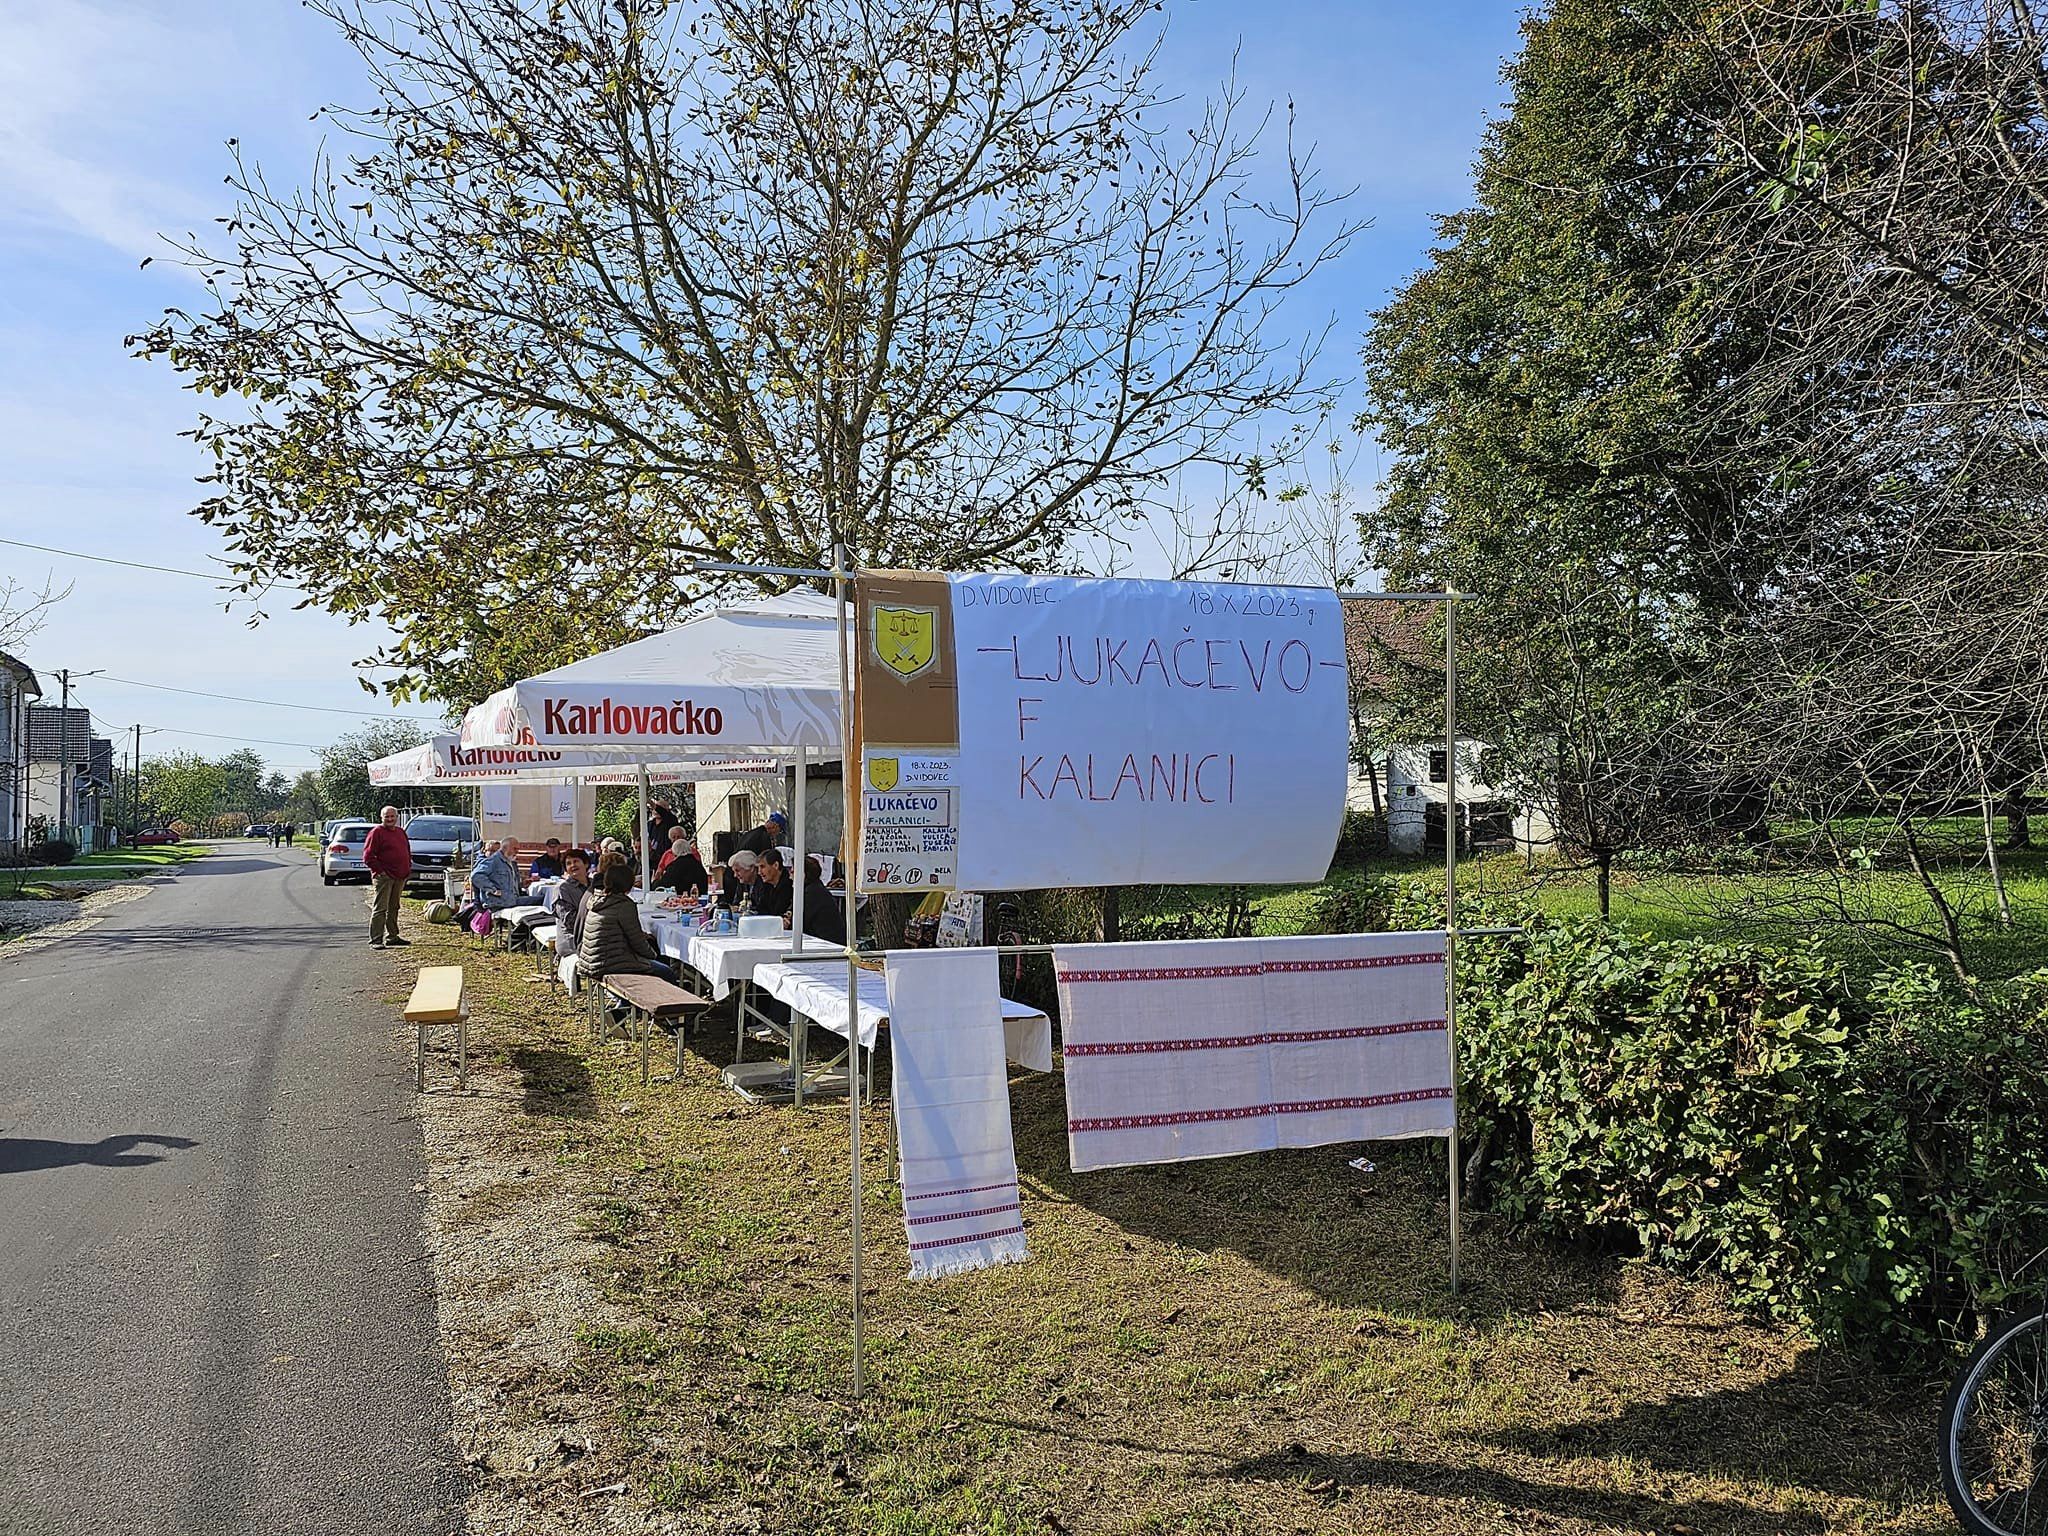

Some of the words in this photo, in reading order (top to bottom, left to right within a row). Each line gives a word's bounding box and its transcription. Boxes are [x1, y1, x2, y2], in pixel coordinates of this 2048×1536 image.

[543, 697, 723, 735] Karlovačko
[1018, 697, 1043, 741] F
[1020, 753, 1234, 803] KALANICI
[869, 792, 938, 812] LUKAČEVO
